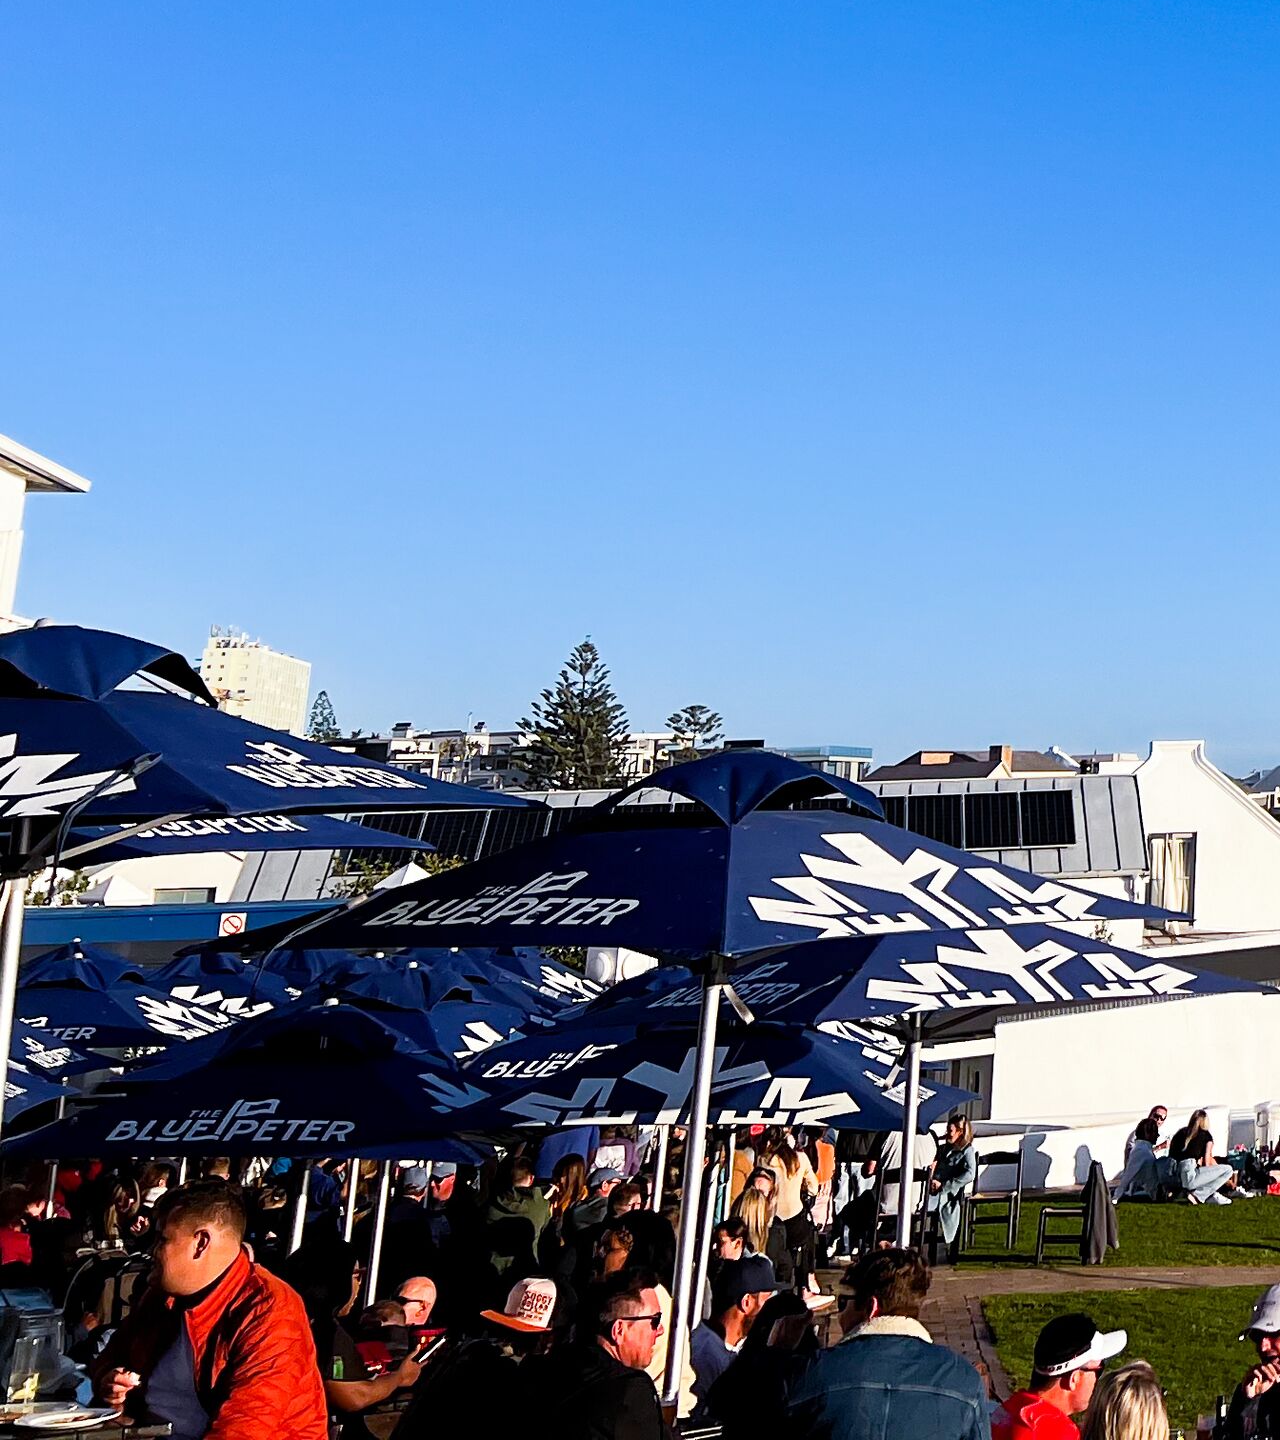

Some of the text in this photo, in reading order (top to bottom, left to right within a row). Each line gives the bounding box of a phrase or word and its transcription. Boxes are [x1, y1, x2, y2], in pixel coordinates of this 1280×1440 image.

[476, 886, 519, 896] THE
[362, 897, 640, 927] BLUE PETER
[481, 1060, 567, 1078] BLUE
[189, 1110, 223, 1118] THE
[105, 1119, 356, 1141] BLUE PETER
